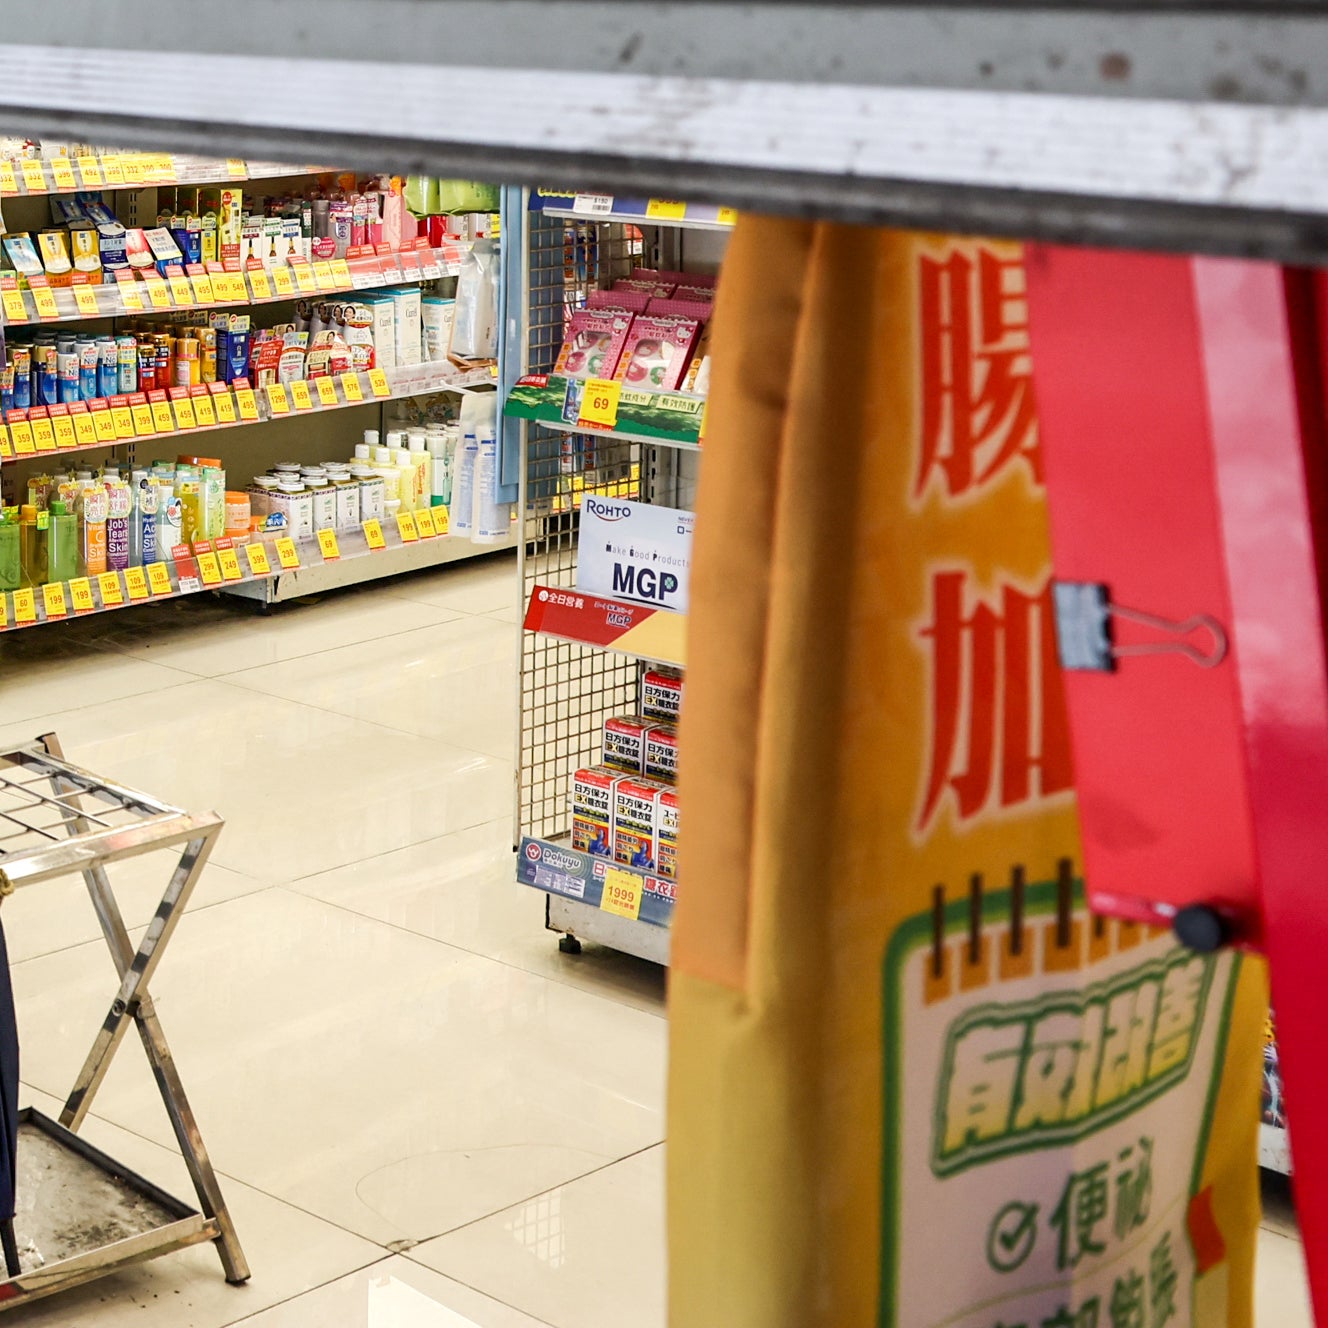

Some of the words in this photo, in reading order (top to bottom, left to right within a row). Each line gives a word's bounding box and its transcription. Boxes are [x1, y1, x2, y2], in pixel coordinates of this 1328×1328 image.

[8, 301, 23, 311] 379
[40, 298, 54, 308] 499
[80, 295, 94, 305] 499
[153, 290, 166, 299] 499
[176, 287, 189, 296] 449
[215, 282, 228, 292] 499
[231, 282, 244, 292] 549
[17, 433, 31, 443] 359
[38, 430, 52, 440] 359
[59, 427, 73, 438] 359
[80, 424, 93, 434] 349
[99, 422, 112, 432] 349
[118, 419, 132, 429] 349
[138, 416, 151, 426] 399
[158, 413, 171, 423] 459
[179, 409, 192, 420] 459
[199, 407, 212, 417] 419
[220, 403, 233, 414] 419
[242, 400, 255, 410] 495
[270, 395, 286, 405] 1299
[295, 391, 308, 401] 659
[321, 386, 334, 396] 659
[373, 378, 386, 388] 529
[594, 397, 609, 410] 69
[587, 499, 632, 518] ROHTO
[606, 542, 628, 557] Make
[630, 546, 650, 561] Good
[19, 598, 28, 609] 60
[50, 595, 63, 606] 199
[76, 590, 89, 601] 199
[104, 580, 116, 590] 109
[129, 575, 142, 586] 109
[153, 571, 165, 581] 109
[203, 562, 215, 572] 299
[225, 559, 237, 570] 249
[252, 554, 265, 565] 399
[281, 548, 295, 559] 299
[324, 538, 333, 549] 69
[370, 529, 379, 539] 69
[402, 522, 414, 532] 199
[420, 519, 431, 529] 199
[436, 515, 448, 525] 199
[612, 562, 679, 601] MGP
[607, 613, 632, 626] MGP
[645, 685, 680, 702] 日方保力
[605, 732, 641, 748] 日方保力
[574, 783, 609, 800] 日方保力
[617, 795, 653, 813] 日方保力
[543, 849, 581, 868] Dokuyu
[608, 885, 635, 902] 1999
